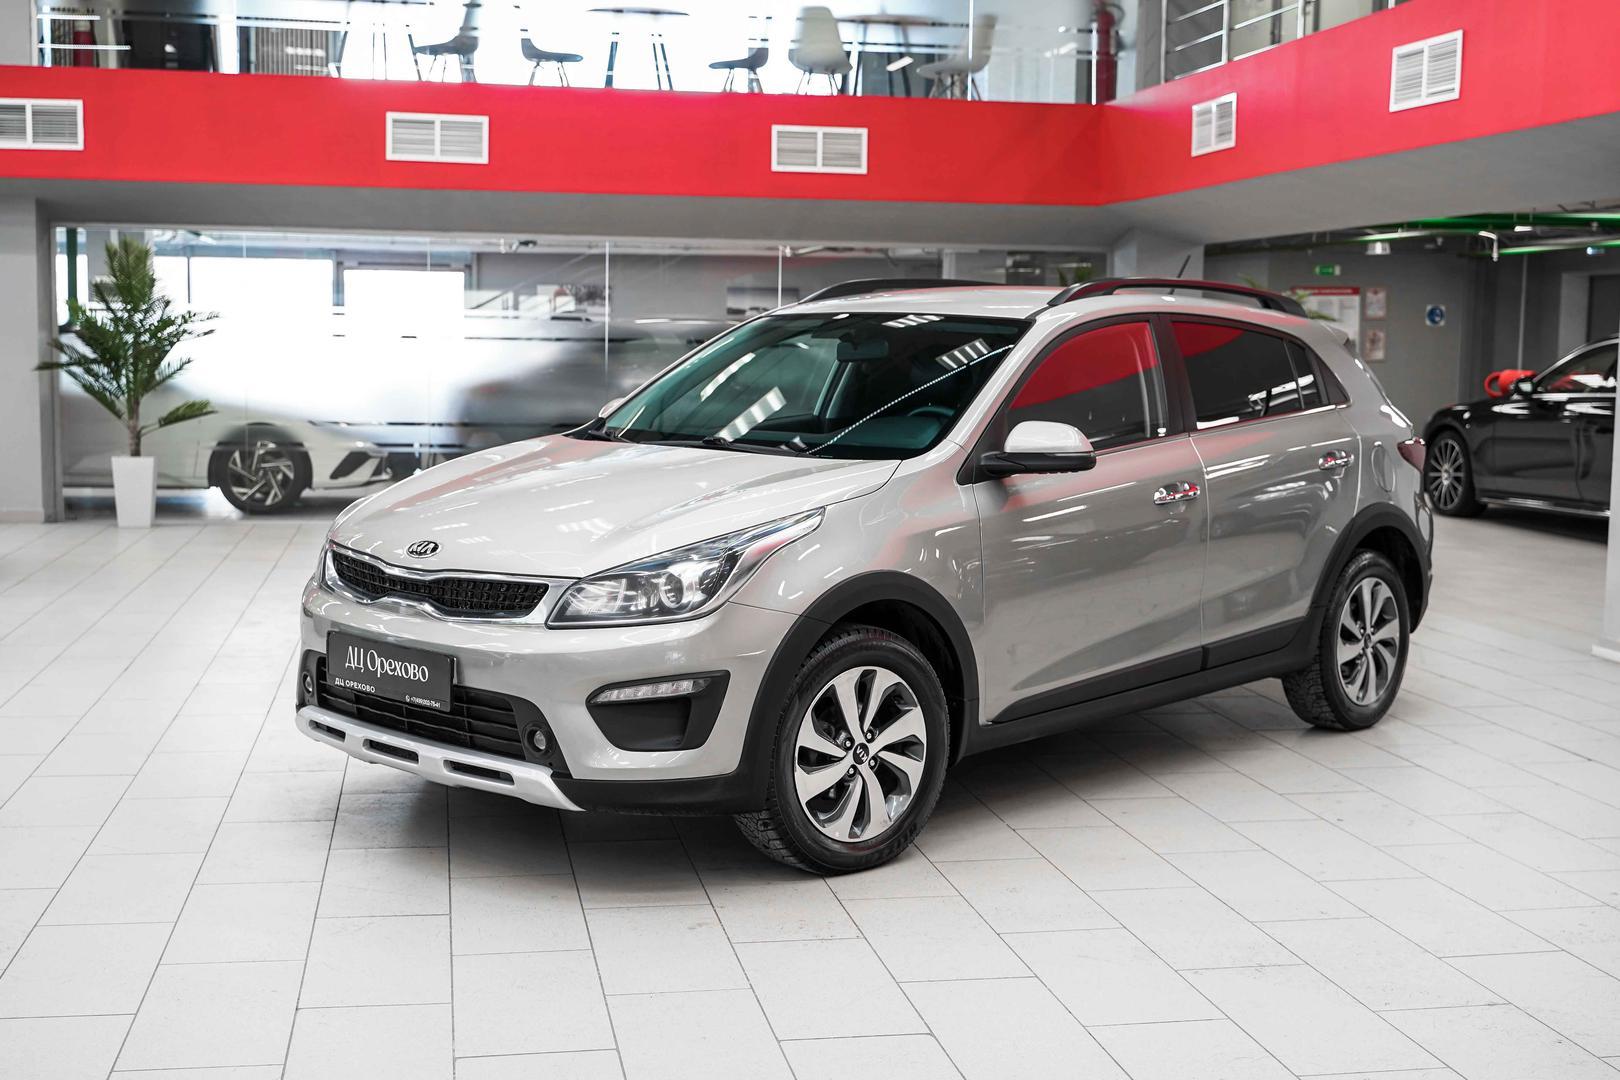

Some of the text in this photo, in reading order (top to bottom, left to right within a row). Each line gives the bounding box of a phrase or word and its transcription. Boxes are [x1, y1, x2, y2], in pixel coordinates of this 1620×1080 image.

[408, 541, 437, 556] KIA
[345, 645, 429, 682] ДЦ Орехово
[334, 677, 376, 693] ДЦ ОРЕХОВО
[856, 745, 868, 763] KIA
